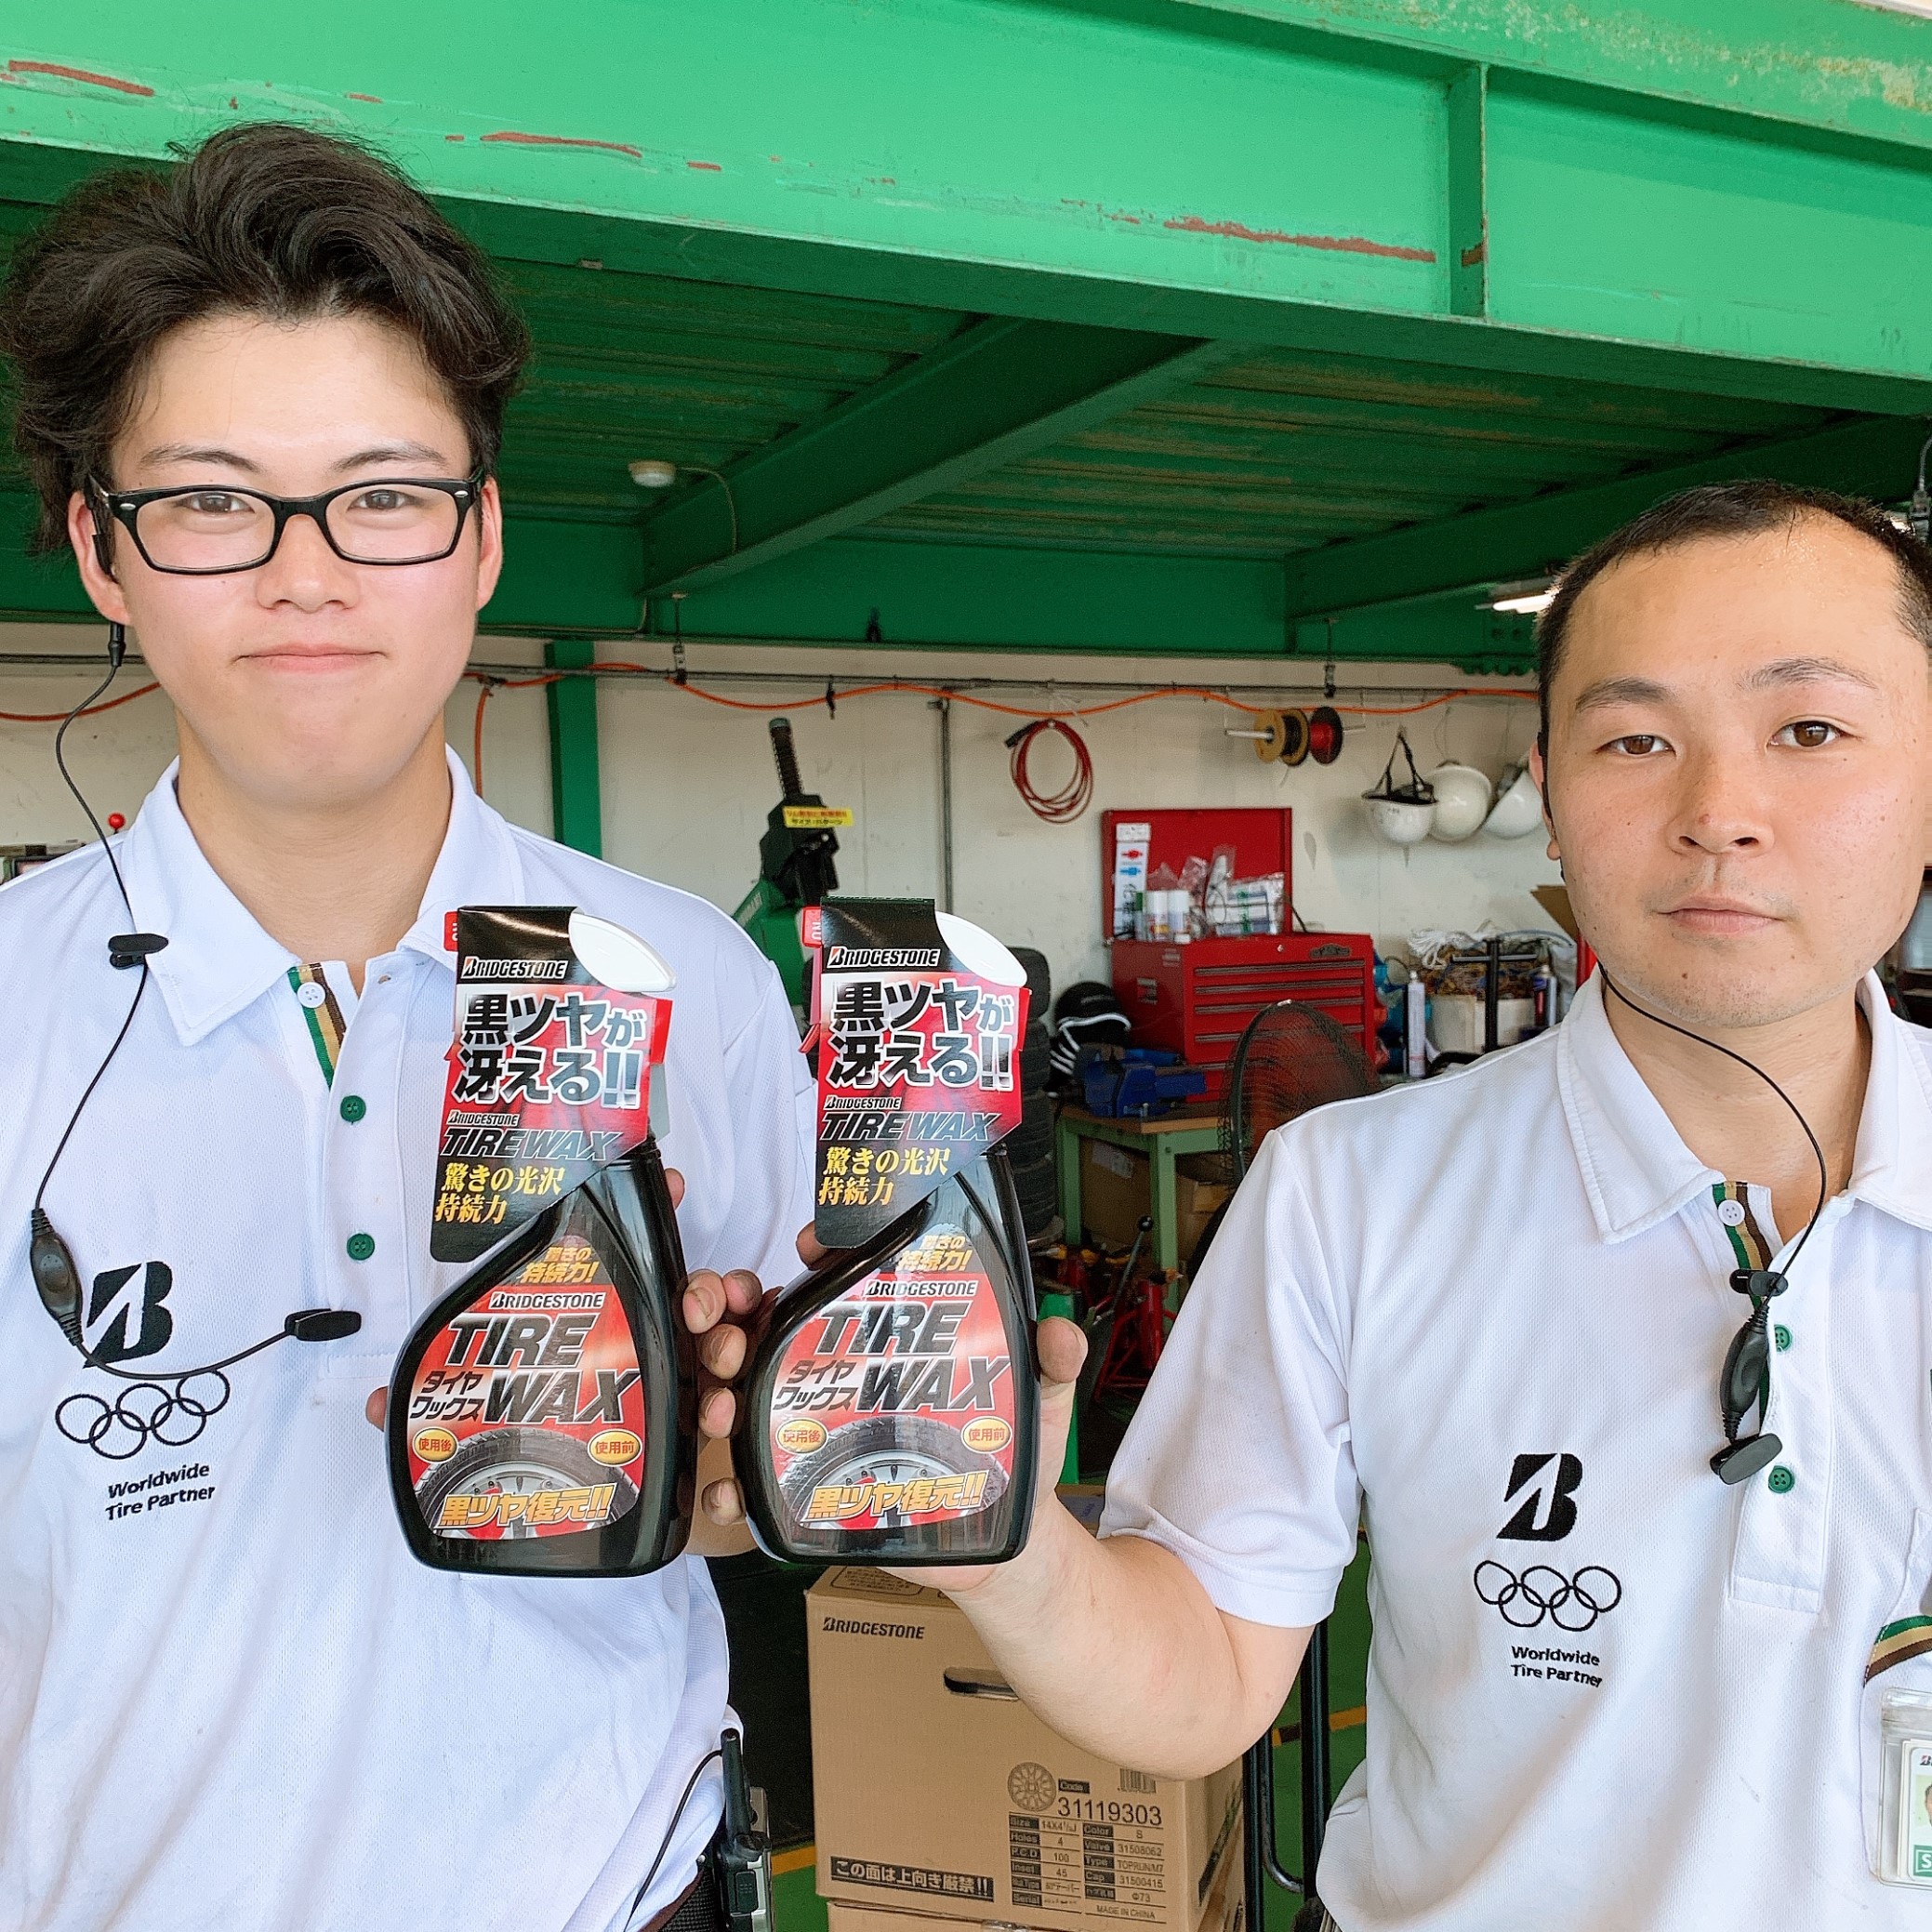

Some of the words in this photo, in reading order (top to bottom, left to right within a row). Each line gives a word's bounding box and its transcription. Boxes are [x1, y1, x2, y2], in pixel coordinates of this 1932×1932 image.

[463, 957, 568, 978] BRIDGESTONE
[827, 946, 941, 967] BRIDGESTONE
[831, 978, 1015, 1034] 黒ツヤが
[462, 991, 646, 1049] 黒ツヤが
[827, 1033, 1014, 1091] 冴える!!
[452, 1048, 642, 1107] 冴える!!
[823, 1096, 901, 1110] BRIDGESTONE
[447, 1110, 520, 1127] BRIDGESTONE
[820, 1111, 909, 1141] TIRE
[906, 1111, 1000, 1142] WAX
[440, 1128, 526, 1158] TIRE
[522, 1129, 621, 1160] WAX
[823, 1147, 951, 1176] 驚きの光沢
[441, 1163, 566, 1194] 驚きの光沢
[818, 1177, 894, 1206] 持続力
[435, 1194, 508, 1224] 持続力
[489, 1292, 605, 1310] BRIDGESTONE
[864, 1280, 978, 1297] BRIDGESTONE
[445, 1313, 601, 1368] TIRE
[814, 1301, 973, 1356] TIRE
[421, 1370, 483, 1395] タイヤ
[791, 1359, 856, 1384] タイヤ
[483, 1369, 641, 1424] WAX
[855, 1356, 1012, 1413] WAX
[410, 1397, 485, 1422] ワックス
[773, 1386, 858, 1411] ワックス
[418, 1437, 452, 1452] 使用後
[594, 1440, 636, 1454] 使用前
[969, 1428, 1005, 1442] 使用前
[108, 1462, 210, 1499] Worldwide
[105, 1502, 143, 1521] Tire
[148, 1486, 216, 1512] Partner
[435, 1484, 617, 1528] 黒ツヤ復元!!
[803, 1470, 989, 1522] 黒ツヤ復元!!
[823, 1617, 925, 1640] BRIDGESTONE
[1511, 1645, 1600, 1666] Worldwide
[1511, 1664, 1543, 1679] Tire
[1546, 1667, 1603, 1687] Partner
[1057, 1796, 1162, 1826] 31119303
[1011, 1833, 1038, 1844] Holes
[1057, 1836, 1064, 1846] 4
[1084, 1824, 1109, 1835] Color
[1053, 1852, 1069, 1862] 100
[1084, 1841, 1111, 1851] Valve
[1056, 1868, 1067, 1877] 45
[1085, 1856, 1109, 1867] Type
[836, 1860, 988, 1896] この面は上向き厳禁!!
[1086, 1872, 1105, 1883] Cap
